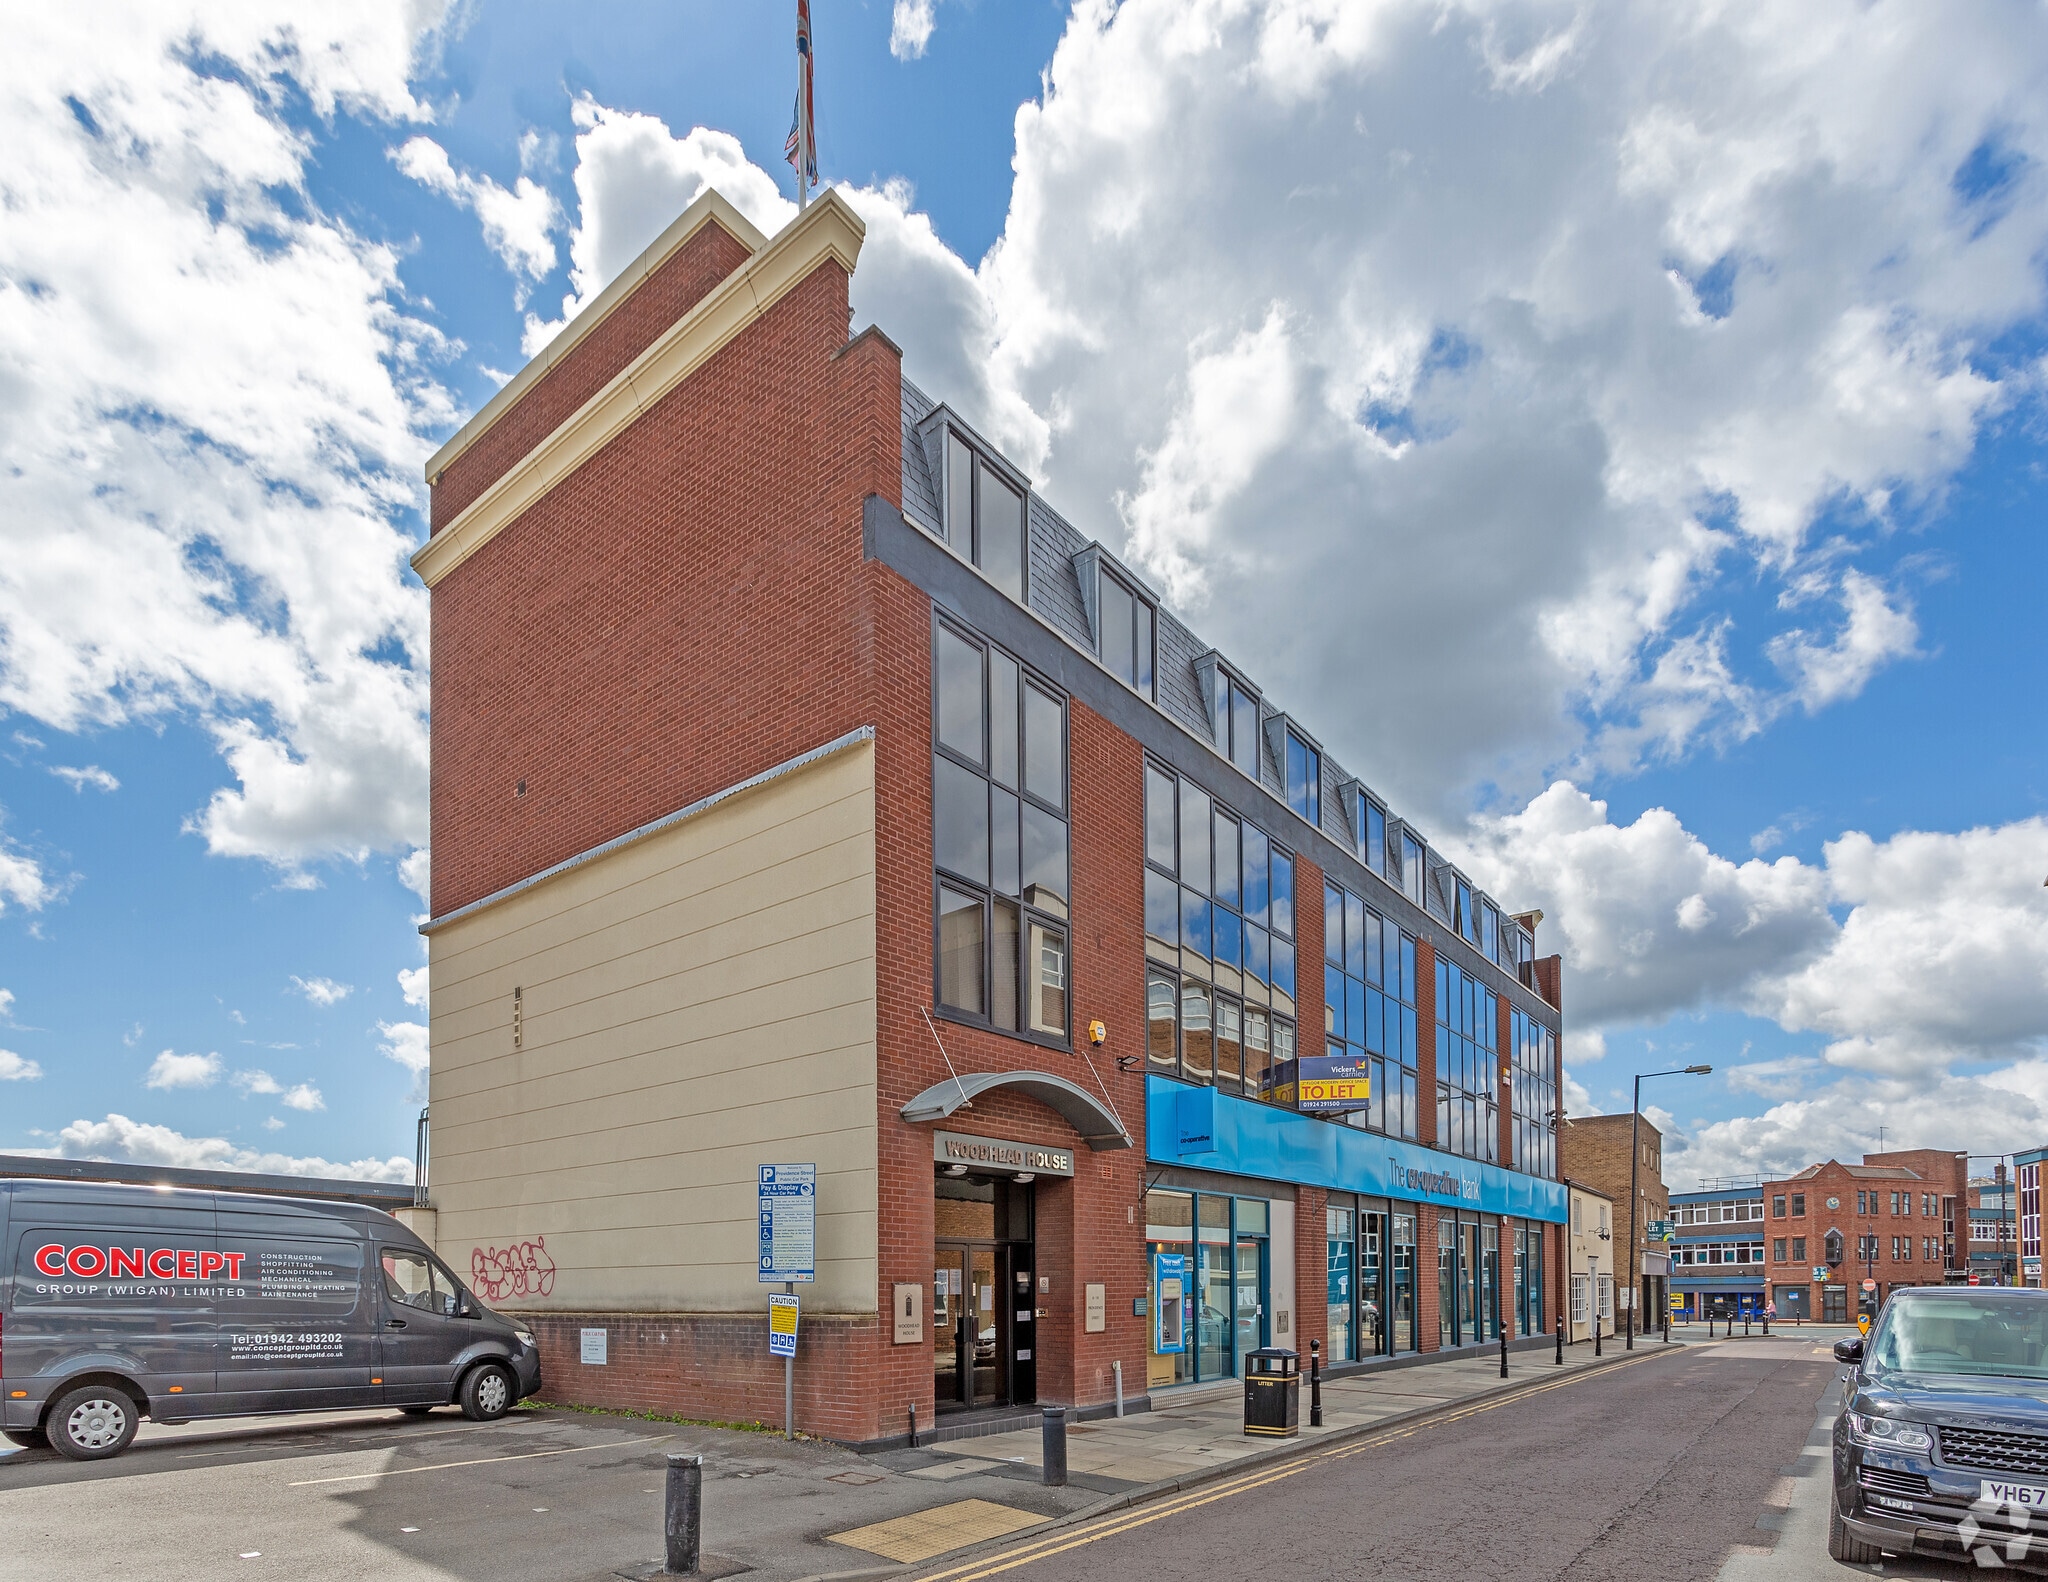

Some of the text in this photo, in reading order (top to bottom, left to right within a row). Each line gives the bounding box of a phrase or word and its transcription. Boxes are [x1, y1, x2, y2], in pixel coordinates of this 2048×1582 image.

[1331, 1065, 1355, 1073] Vickers
[1341, 1070, 1366, 1078] carnley
[1302, 1084, 1355, 1099] TO LET
[945, 1140, 1068, 1170] WOODHEAD HOUSE
[1389, 1157, 1480, 1200] The co-operative bank
[34, 1243, 246, 1281] CONCEPT
[260, 1253, 322, 1261] CONSTRUCTION
[36, 1284, 246, 1297] GROUP (WIGAN) LIMITED
[771, 1297, 797, 1305] CAUTION
[230, 1333, 342, 1344] Tel:01942 493202
[231, 1344, 343, 1352] www.conceptgroupltd.co.uk
[231, 1352, 344, 1360] email:info@conceptgroupltd.co.uk
[1990, 1483, 2046, 1505] YH67
